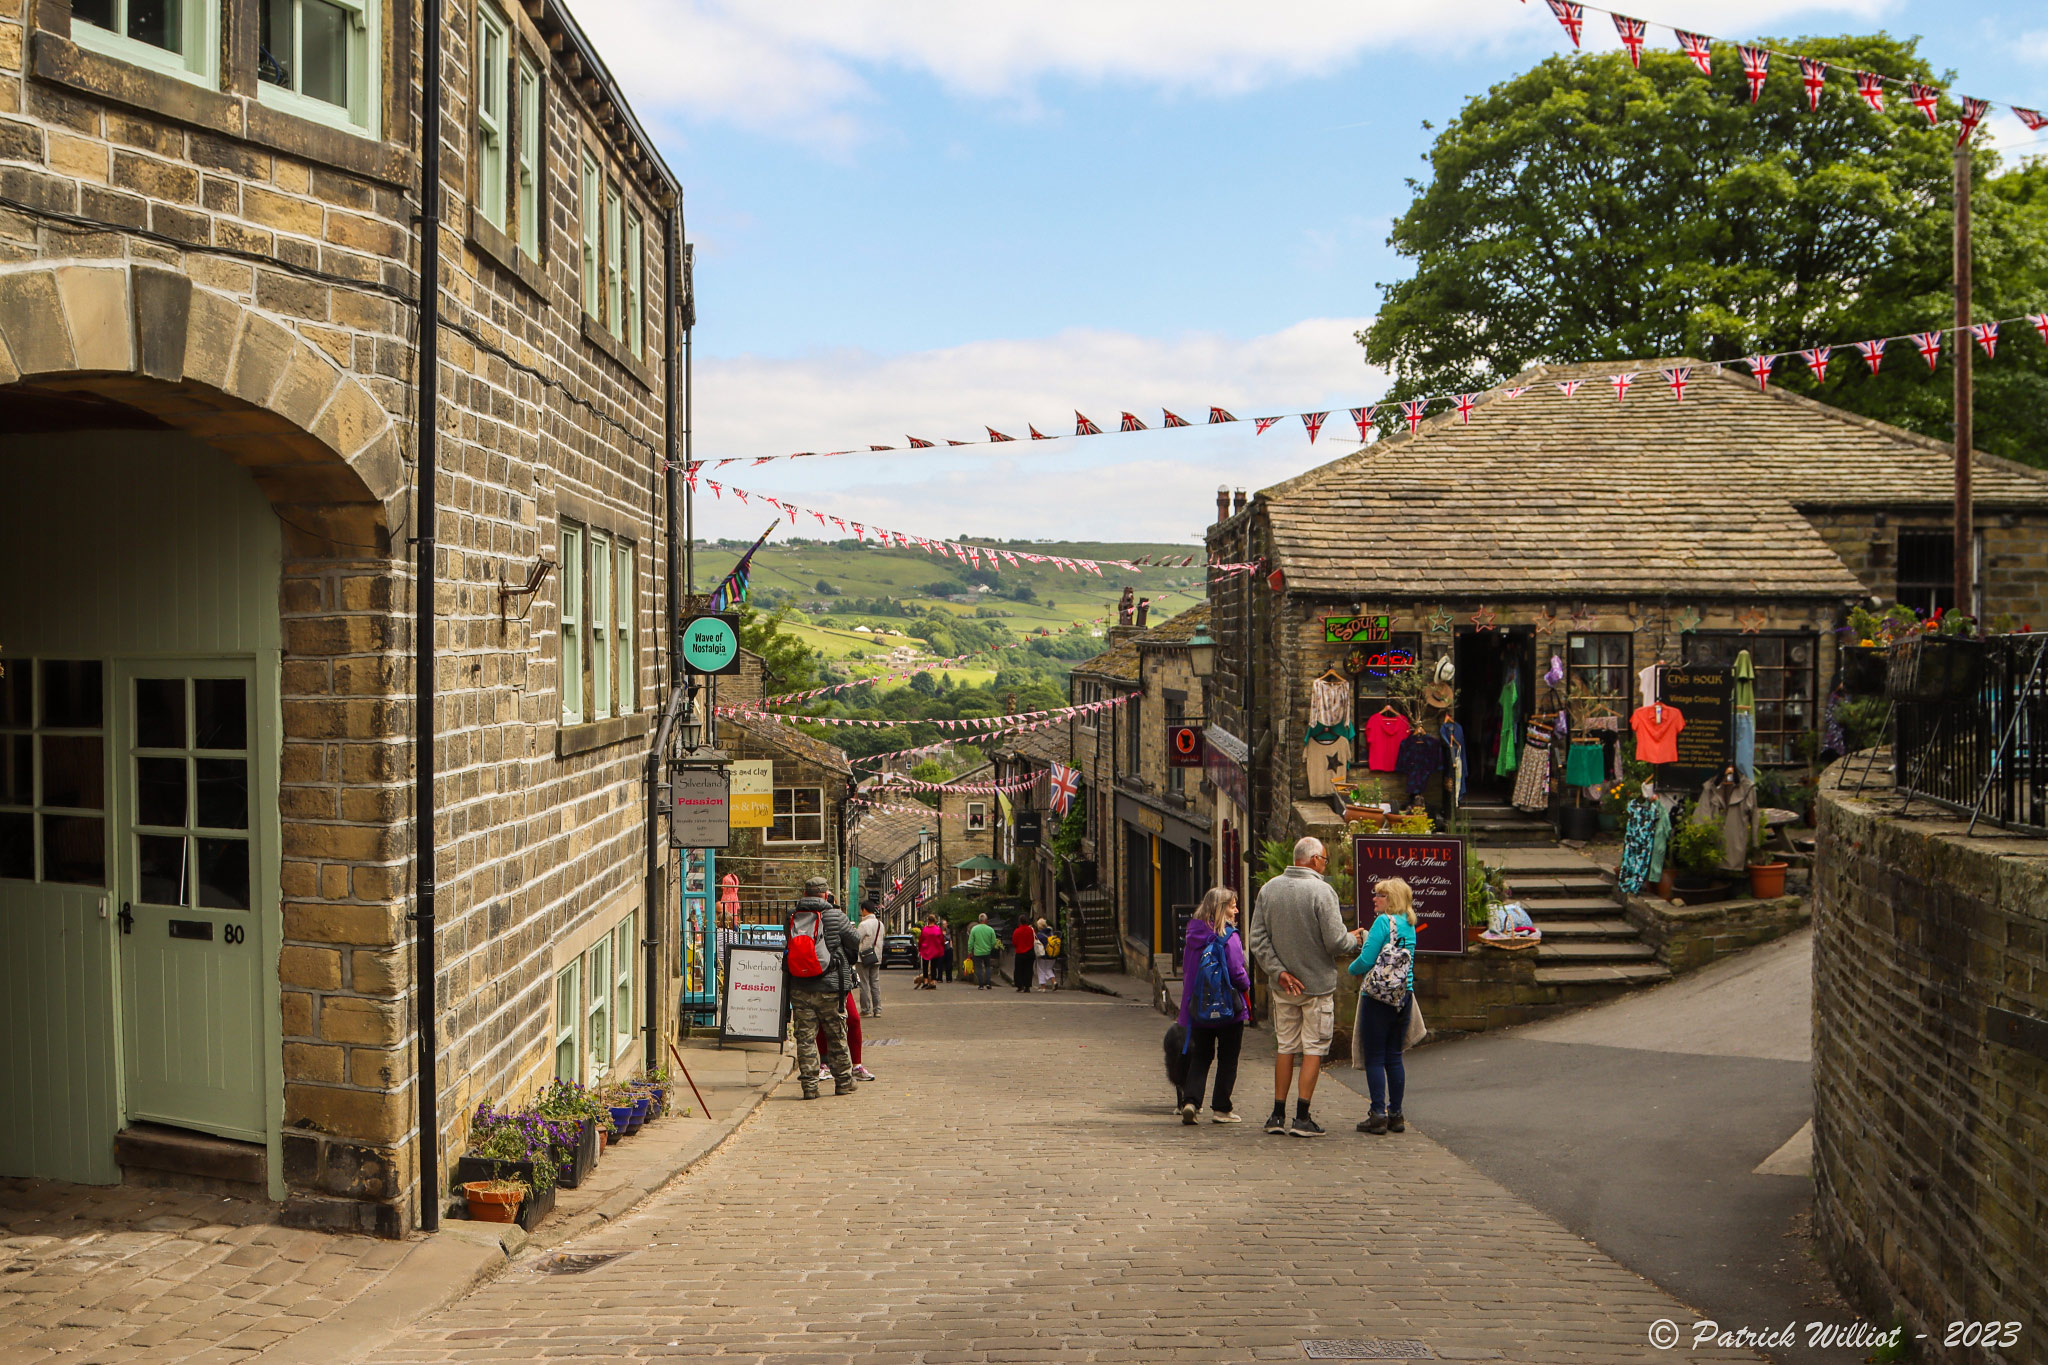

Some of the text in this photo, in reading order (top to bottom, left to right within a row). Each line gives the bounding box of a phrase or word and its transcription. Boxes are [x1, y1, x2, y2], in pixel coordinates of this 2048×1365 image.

[695, 632, 723, 642] Wave of
[1368, 628, 1387, 641] 117
[692, 643, 726, 655] Nostalgia
[1367, 654, 1413, 671] OPEN
[1669, 695, 1721, 705] Vintage Clothing
[739, 768, 751, 776] and
[753, 768, 768, 777] clay
[678, 777, 722, 789] Silverland
[678, 797, 723, 806] Passion
[1366, 847, 1453, 861] VILLETTE
[1395, 856, 1448, 868] Coffee House
[1408, 875, 1452, 886] Light Bites,
[1425, 886, 1448, 896] Treats
[1415, 909, 1446, 918] pecialities
[224, 923, 244, 944] 80
[736, 960, 777, 972] Silverland
[734, 982, 776, 992] Passion
